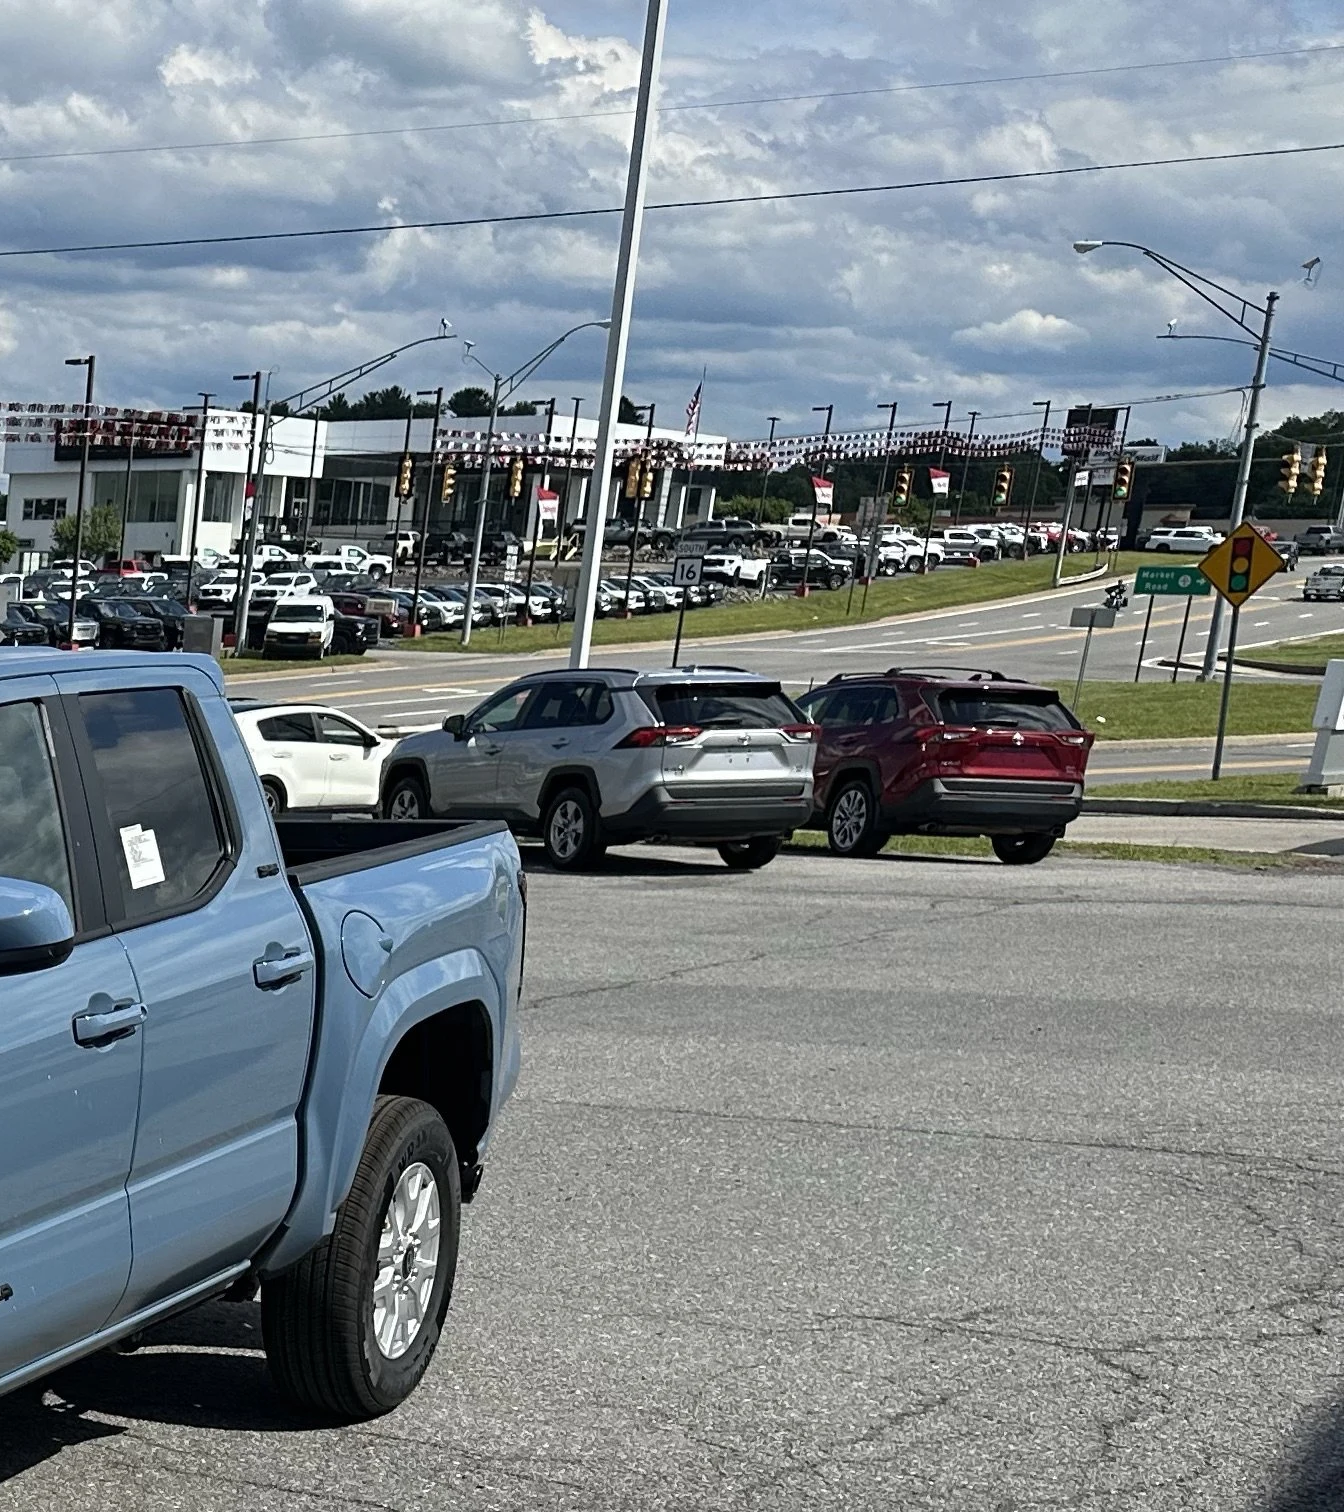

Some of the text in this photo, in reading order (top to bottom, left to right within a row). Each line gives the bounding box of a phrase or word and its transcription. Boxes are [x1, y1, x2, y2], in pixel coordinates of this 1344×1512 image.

[679, 543, 705, 553] SOUTH
[680, 563, 697, 581] 16
[1141, 570, 1175, 579] Market
[1144, 582, 1169, 591] Road
